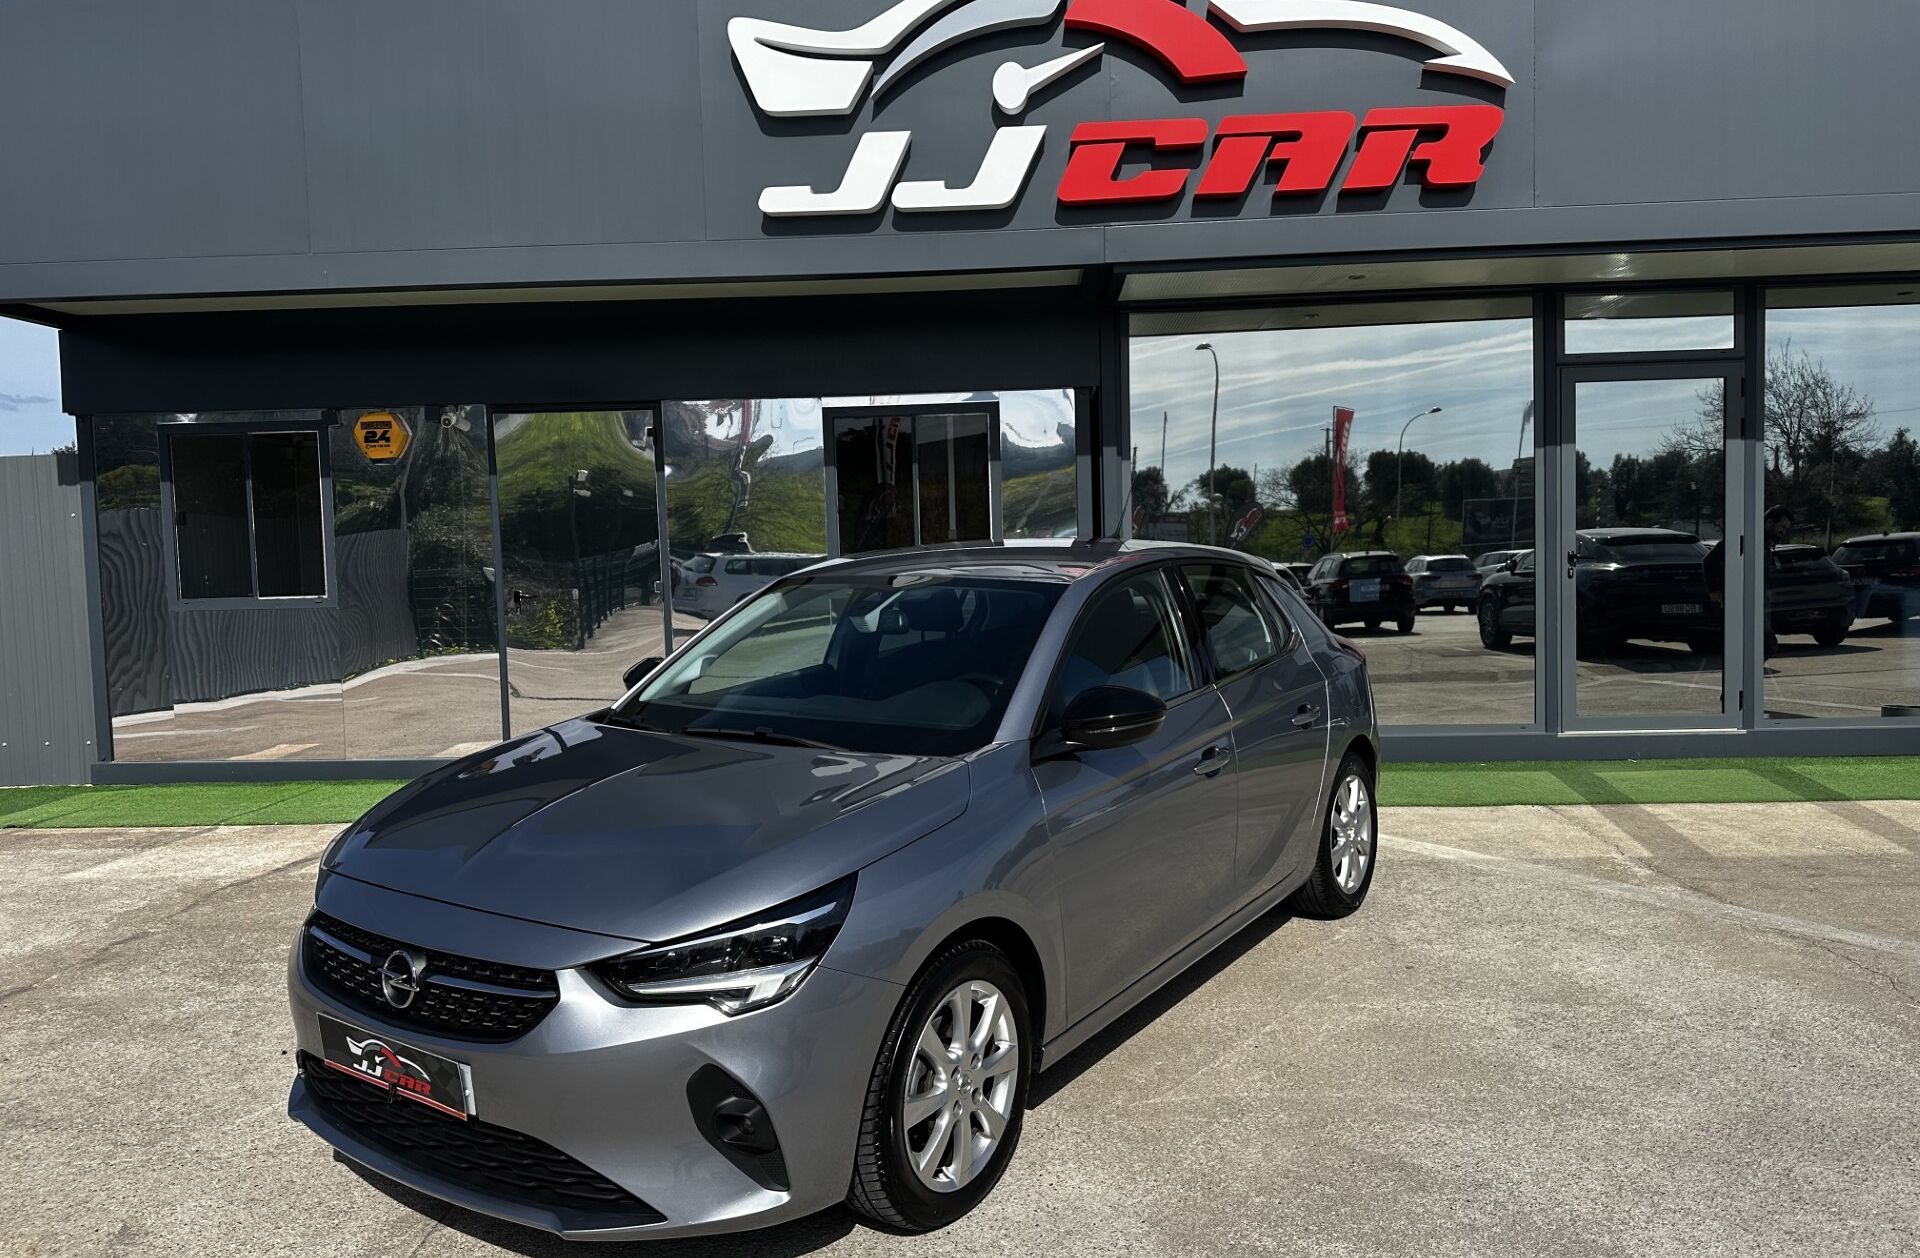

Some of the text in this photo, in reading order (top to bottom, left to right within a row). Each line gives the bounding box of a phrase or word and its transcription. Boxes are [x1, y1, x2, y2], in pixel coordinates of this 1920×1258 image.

[757, 104, 1505, 217] JJ CAR
[364, 430, 391, 443] 24
[353, 1059, 432, 1096] JJ CAR
